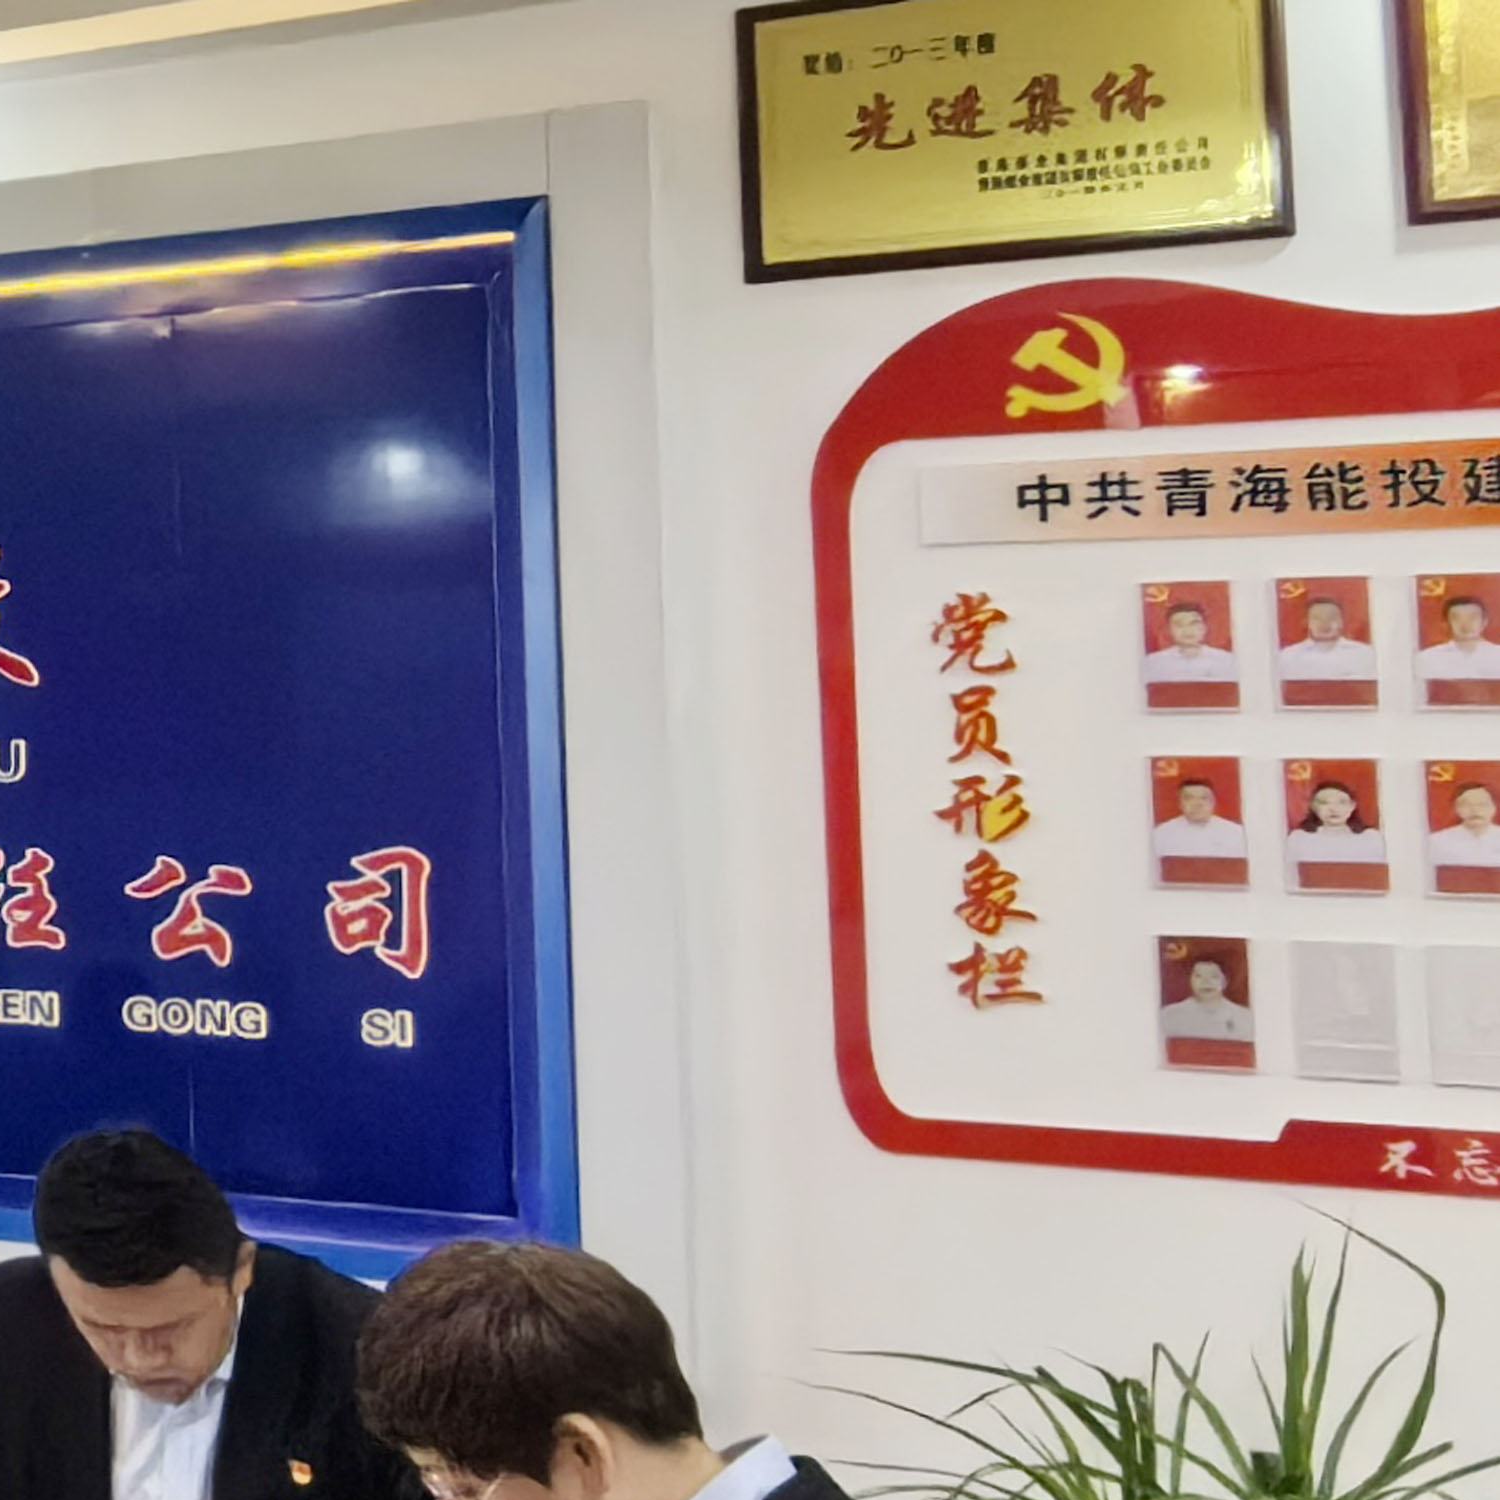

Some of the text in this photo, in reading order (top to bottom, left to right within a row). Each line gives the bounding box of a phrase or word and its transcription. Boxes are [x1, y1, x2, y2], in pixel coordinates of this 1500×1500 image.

[846, 62, 1167, 152] 先进集体
[930, 592, 1045, 1010] 党员形象栏
[122, 995, 268, 1040] GONG
[360, 1009, 414, 1048] SI
[1378, 1138, 1500, 1187] 不忘
